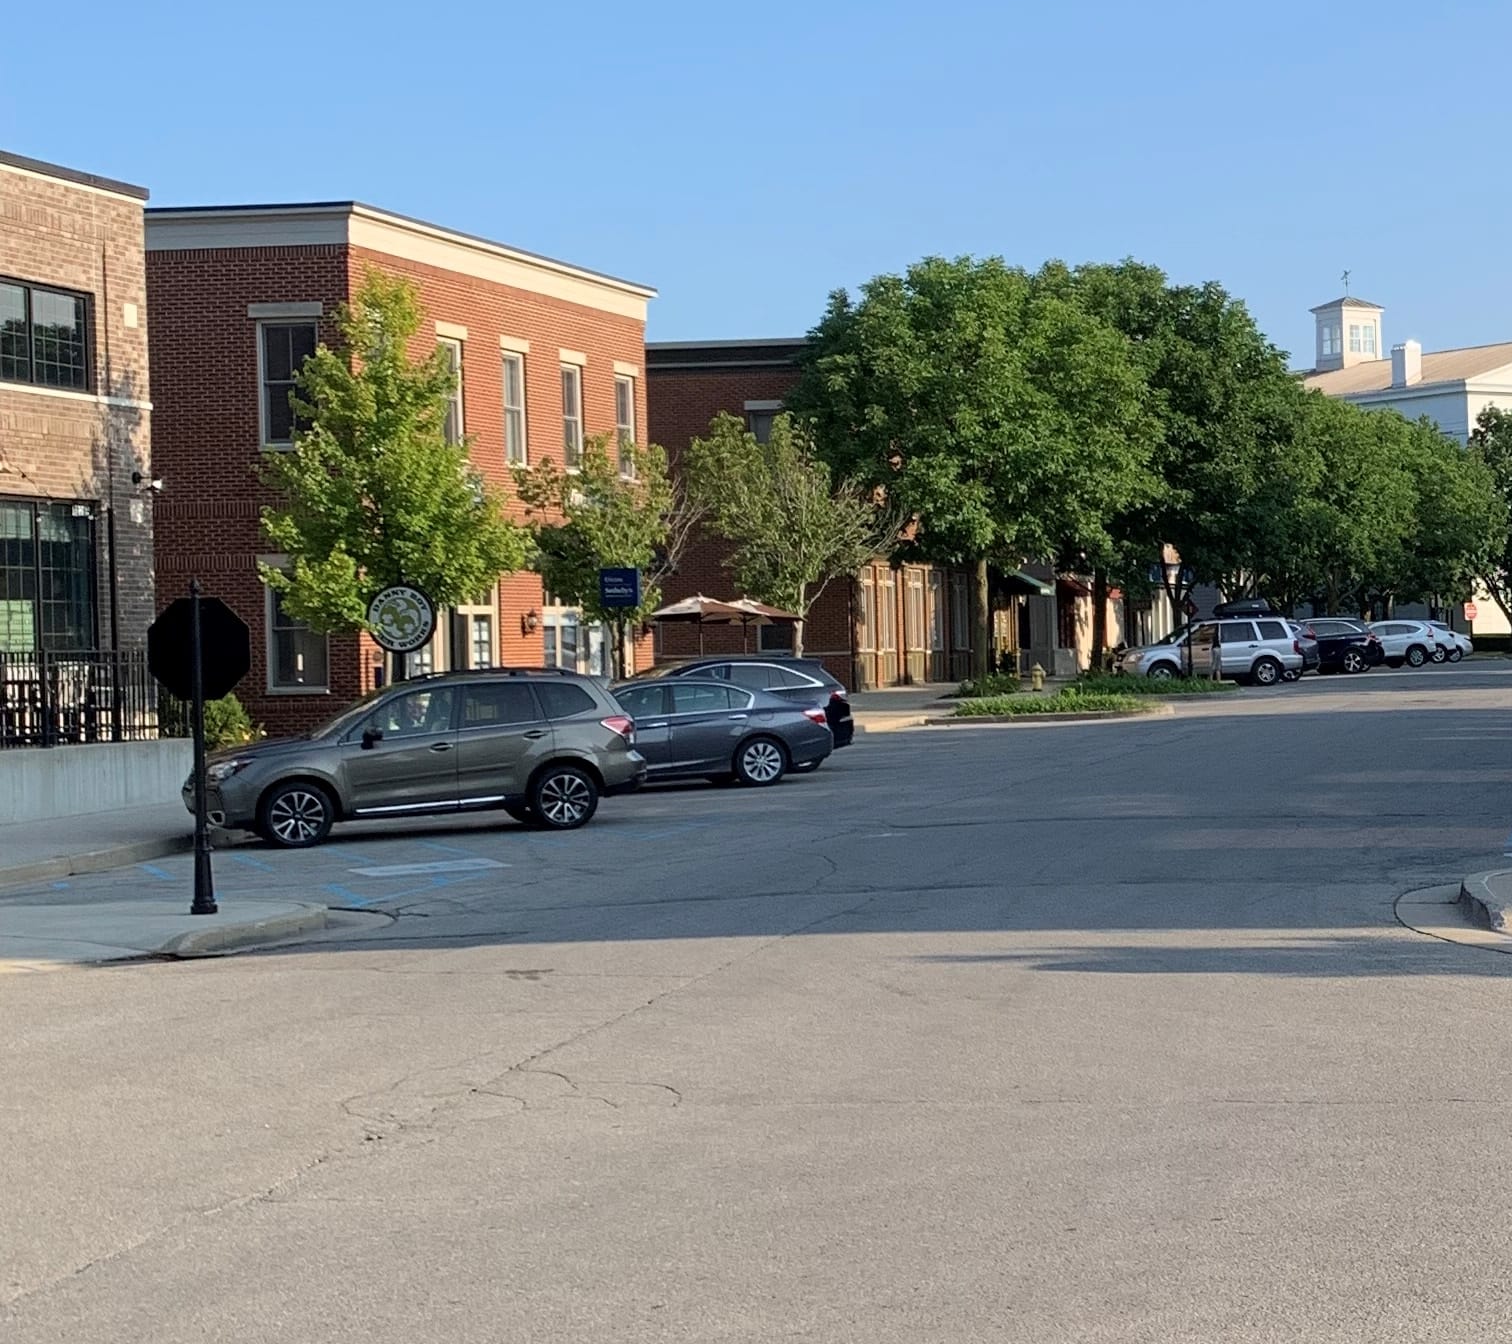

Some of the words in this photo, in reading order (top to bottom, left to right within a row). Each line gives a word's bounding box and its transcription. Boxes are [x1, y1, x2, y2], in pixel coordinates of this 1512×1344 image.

[373, 589, 406, 612] DANNY
[409, 591, 428, 611] BOY
[399, 621, 429, 648] WORKS
